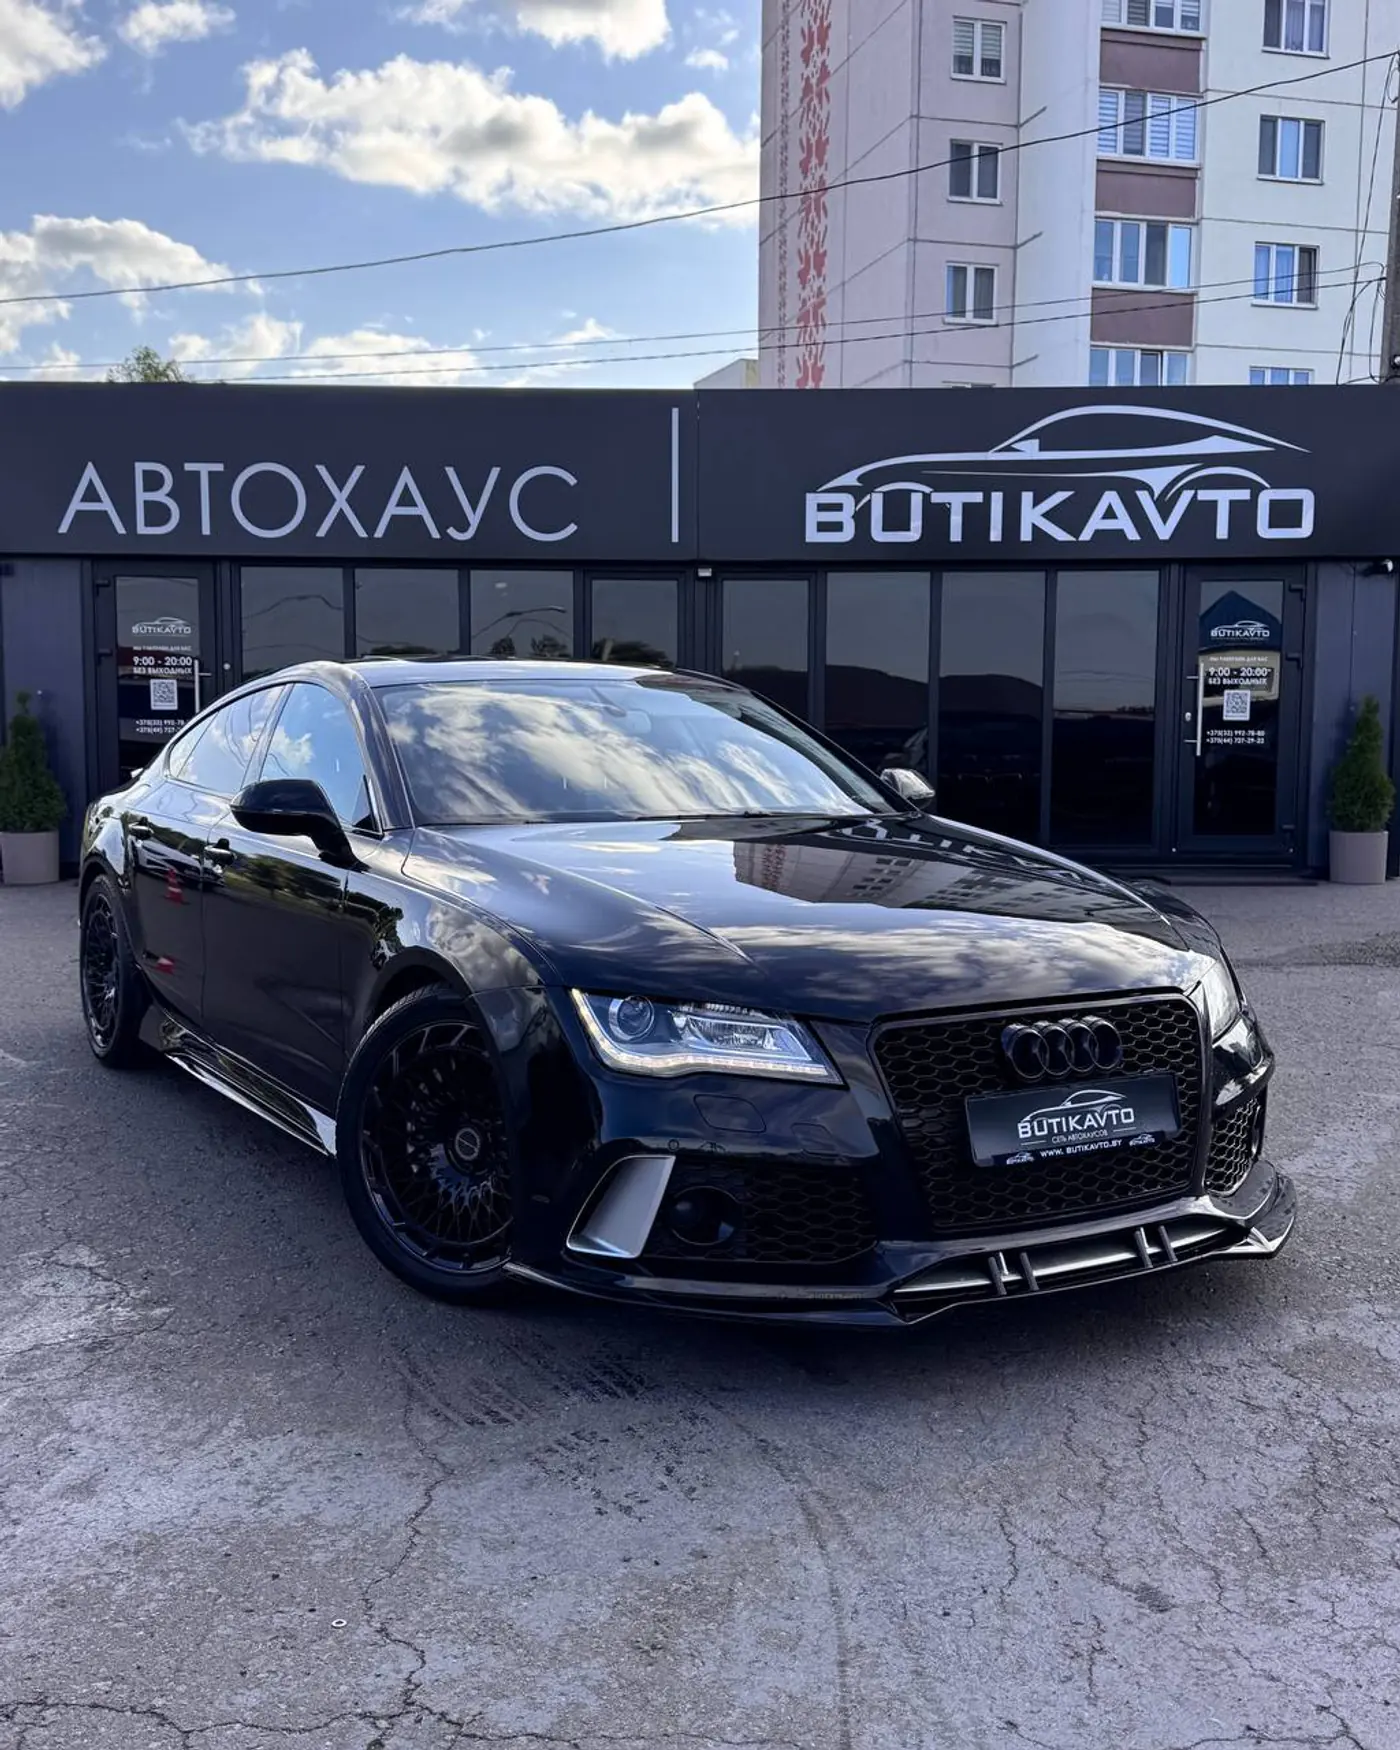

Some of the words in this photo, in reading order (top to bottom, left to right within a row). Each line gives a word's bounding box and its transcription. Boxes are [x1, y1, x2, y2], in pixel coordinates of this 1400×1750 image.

[58, 461, 578, 542] АВТОХАУС
[805, 487, 1315, 543] BUTIKAVTO
[132, 626, 191, 634] BUTIKAVTO
[1210, 629, 1270, 637] BUTIKAVTO
[132, 656, 155, 666] 9:00
[164, 656, 193, 666] 20:00
[1208, 667, 1230, 677] 9:00
[1240, 667, 1268, 677] 20:00
[1017, 1107, 1135, 1138] BUTIKAVTO
[1040, 1149, 1064, 1158] WWW.
[1066, 1139, 1122, 1154] BUTIKAVTO.BY
